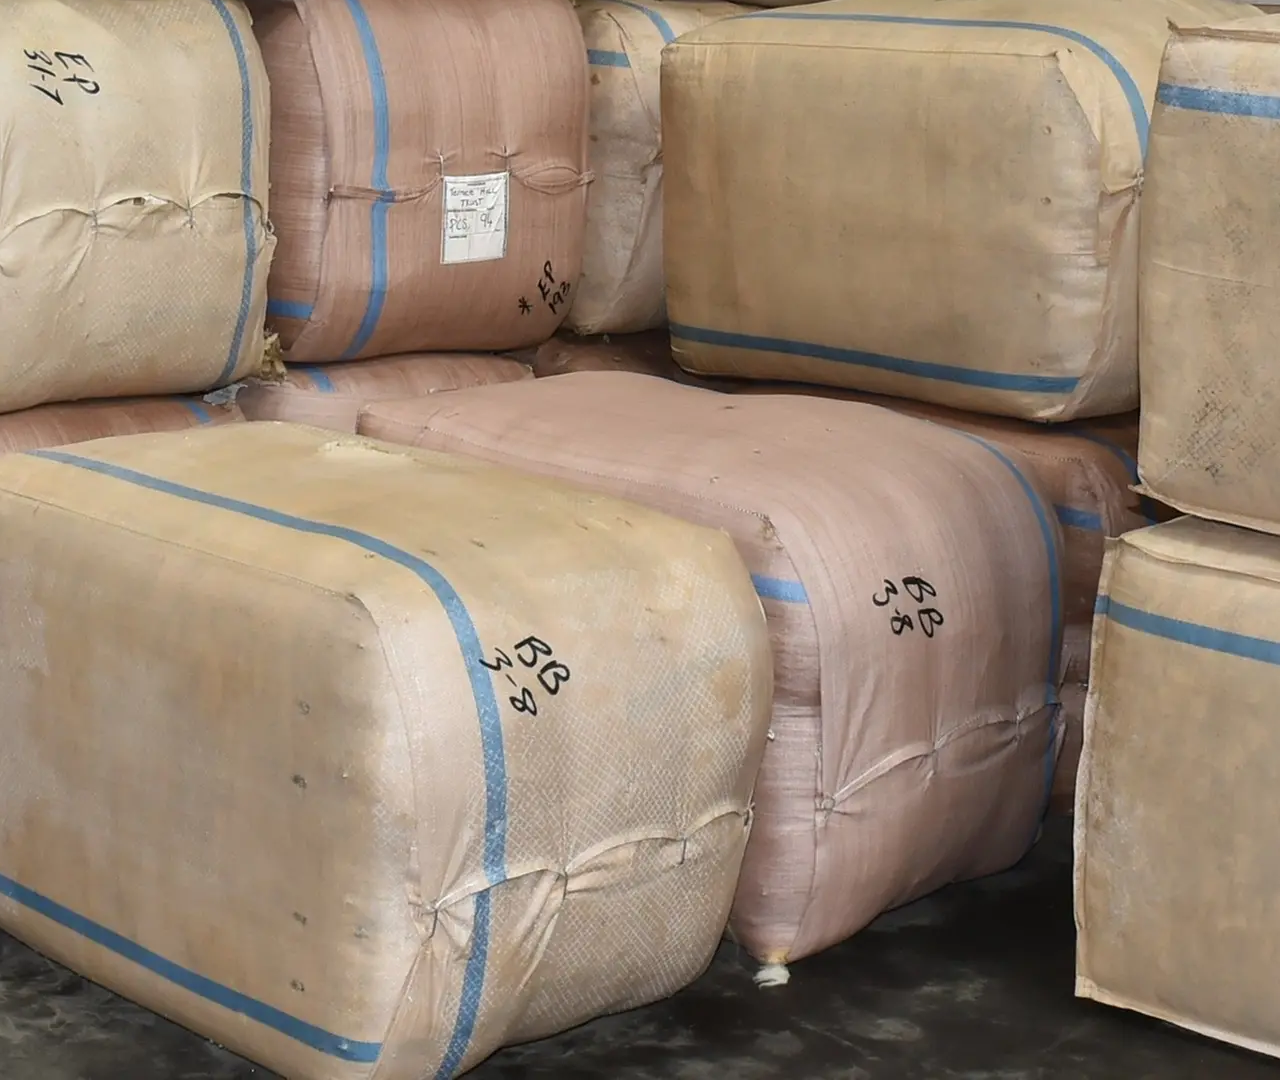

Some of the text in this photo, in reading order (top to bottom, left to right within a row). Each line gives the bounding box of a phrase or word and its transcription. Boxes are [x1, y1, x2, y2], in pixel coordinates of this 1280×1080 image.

[54, 51, 100, 94] EP
[537, 260, 555, 301] EP
[902, 576, 944, 638] BB
[479, 647, 537, 717] 3-8
[514, 636, 570, 696] BB
